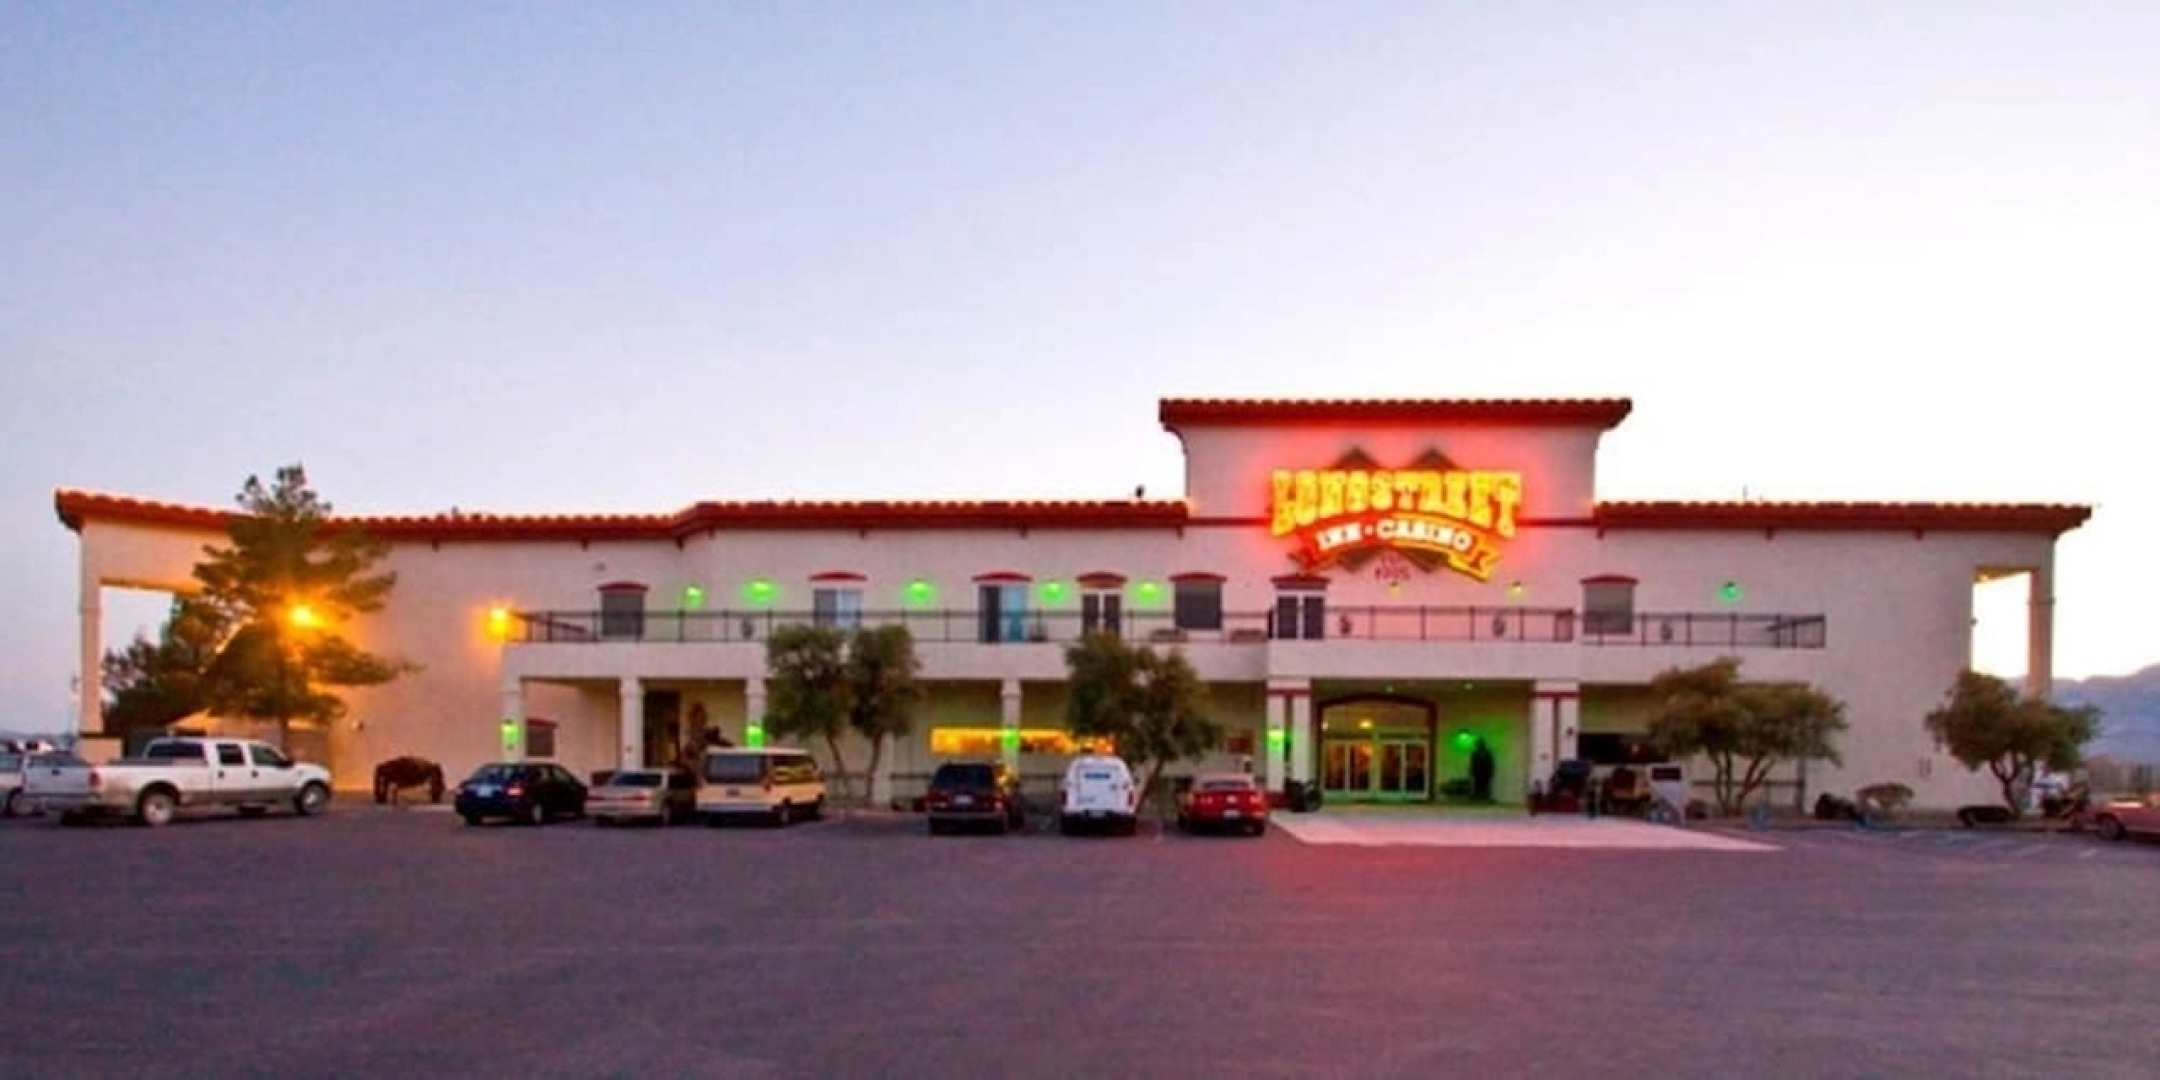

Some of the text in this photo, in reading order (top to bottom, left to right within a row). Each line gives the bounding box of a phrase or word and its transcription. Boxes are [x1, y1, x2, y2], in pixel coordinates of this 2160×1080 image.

[1271, 470, 1522, 537] LONGSTREET
[1317, 519, 1472, 551] INN CASINO
